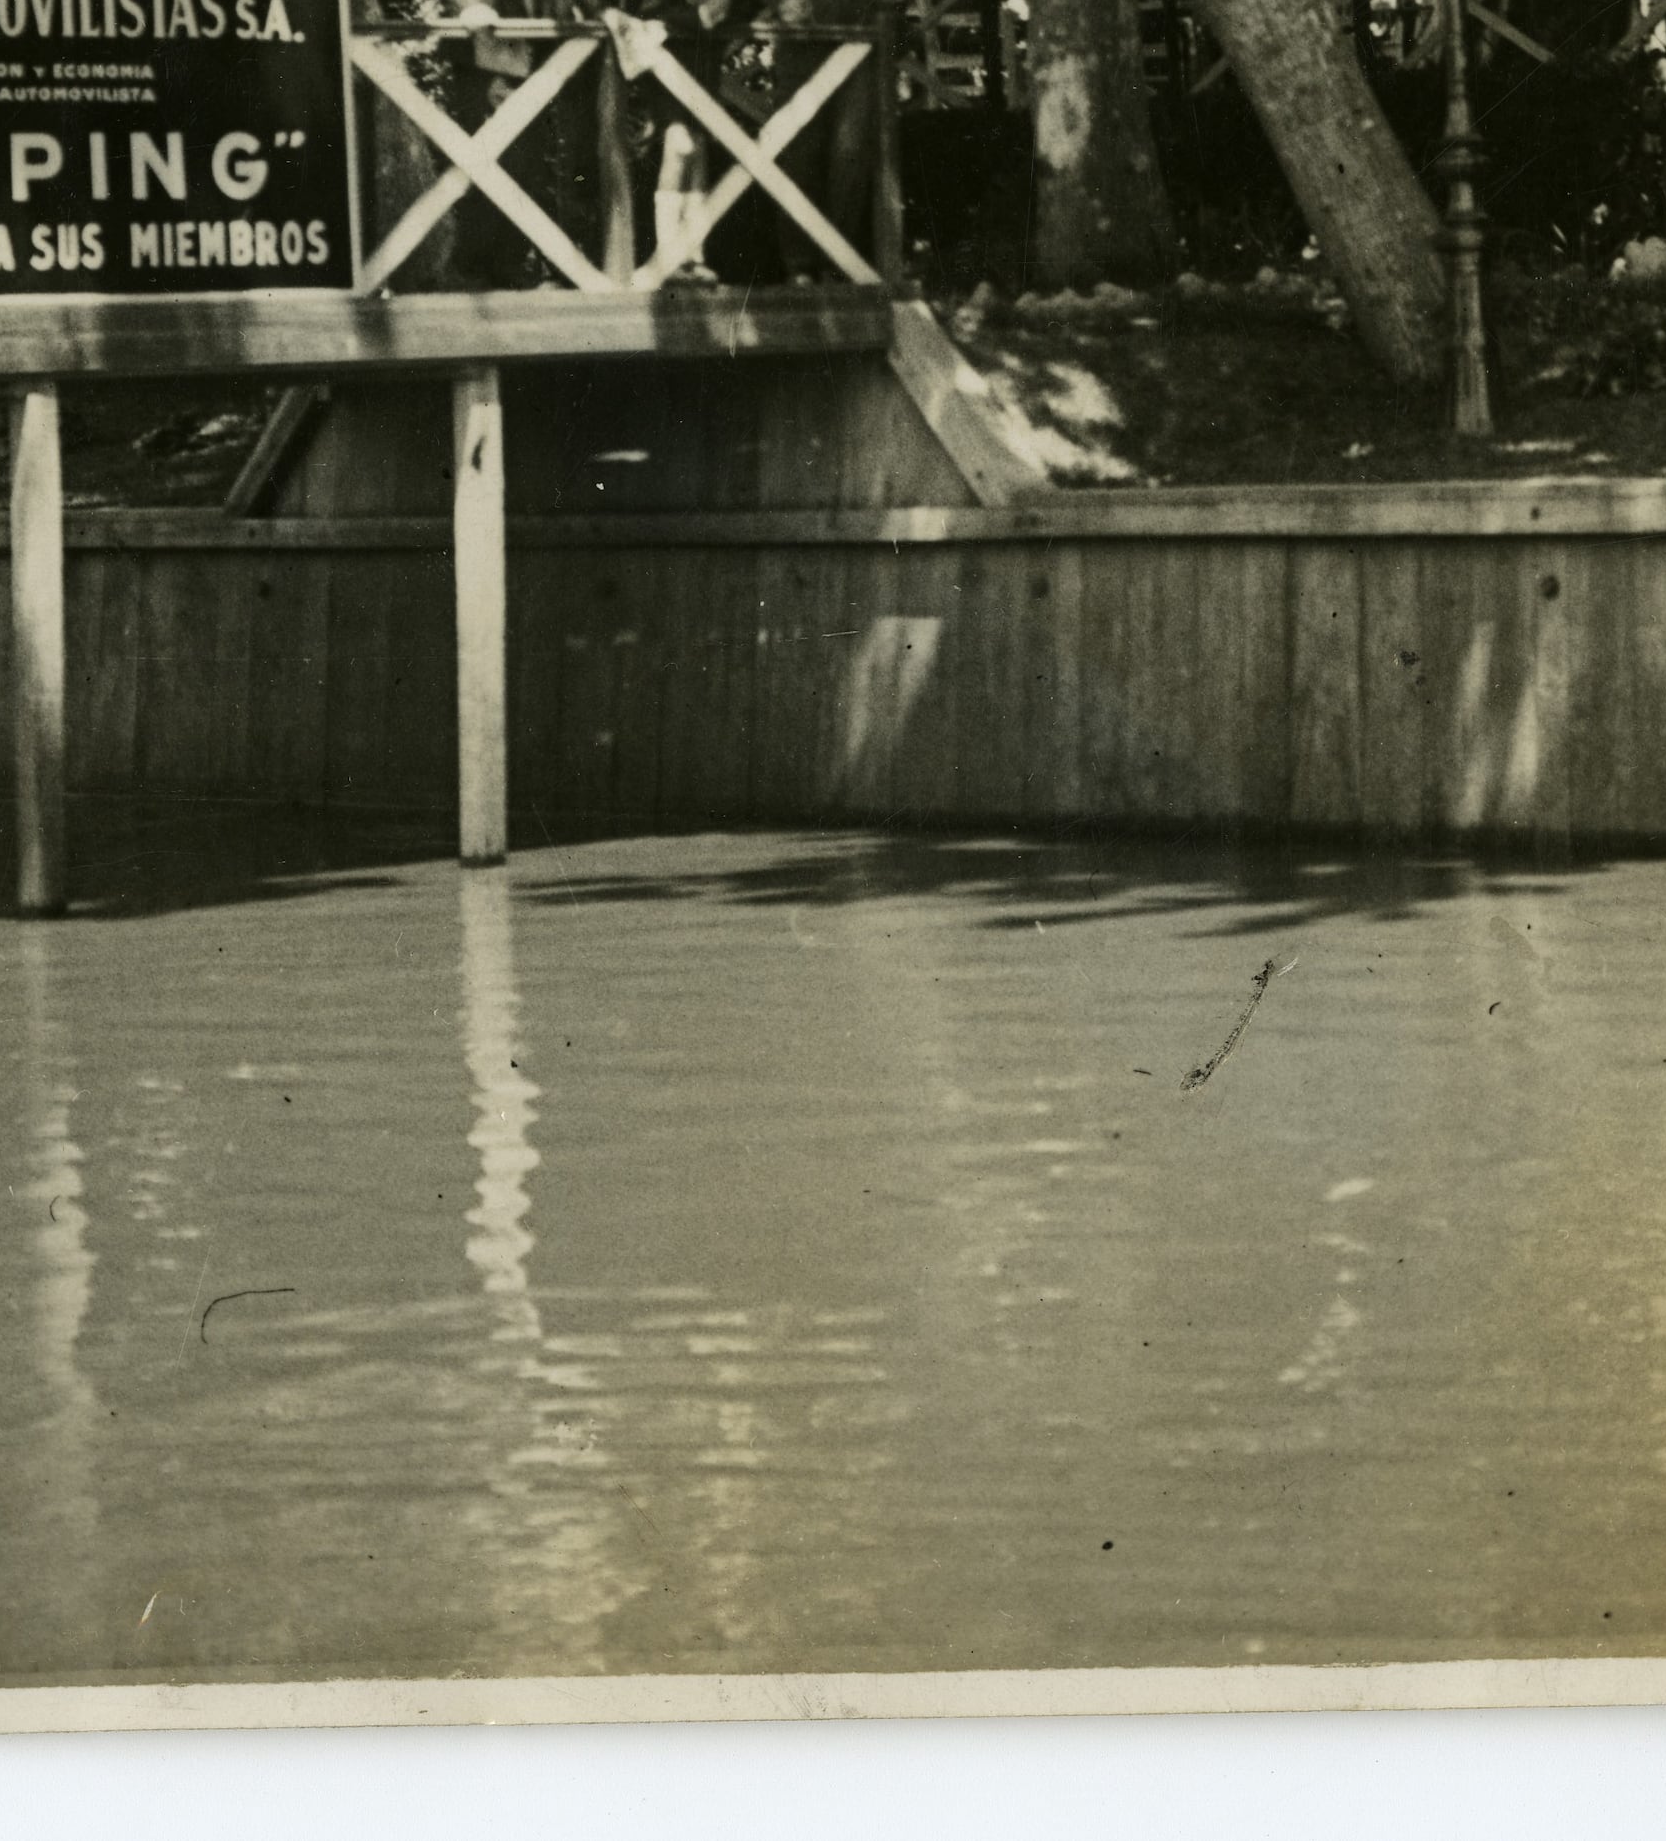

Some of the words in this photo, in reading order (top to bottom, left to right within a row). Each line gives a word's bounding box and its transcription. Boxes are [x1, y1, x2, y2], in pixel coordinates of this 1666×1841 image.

[52, 63, 154, 79] ECONOMIA
[30, 223, 105, 271] SUS
[130, 219, 329, 268] MIEMBROS
